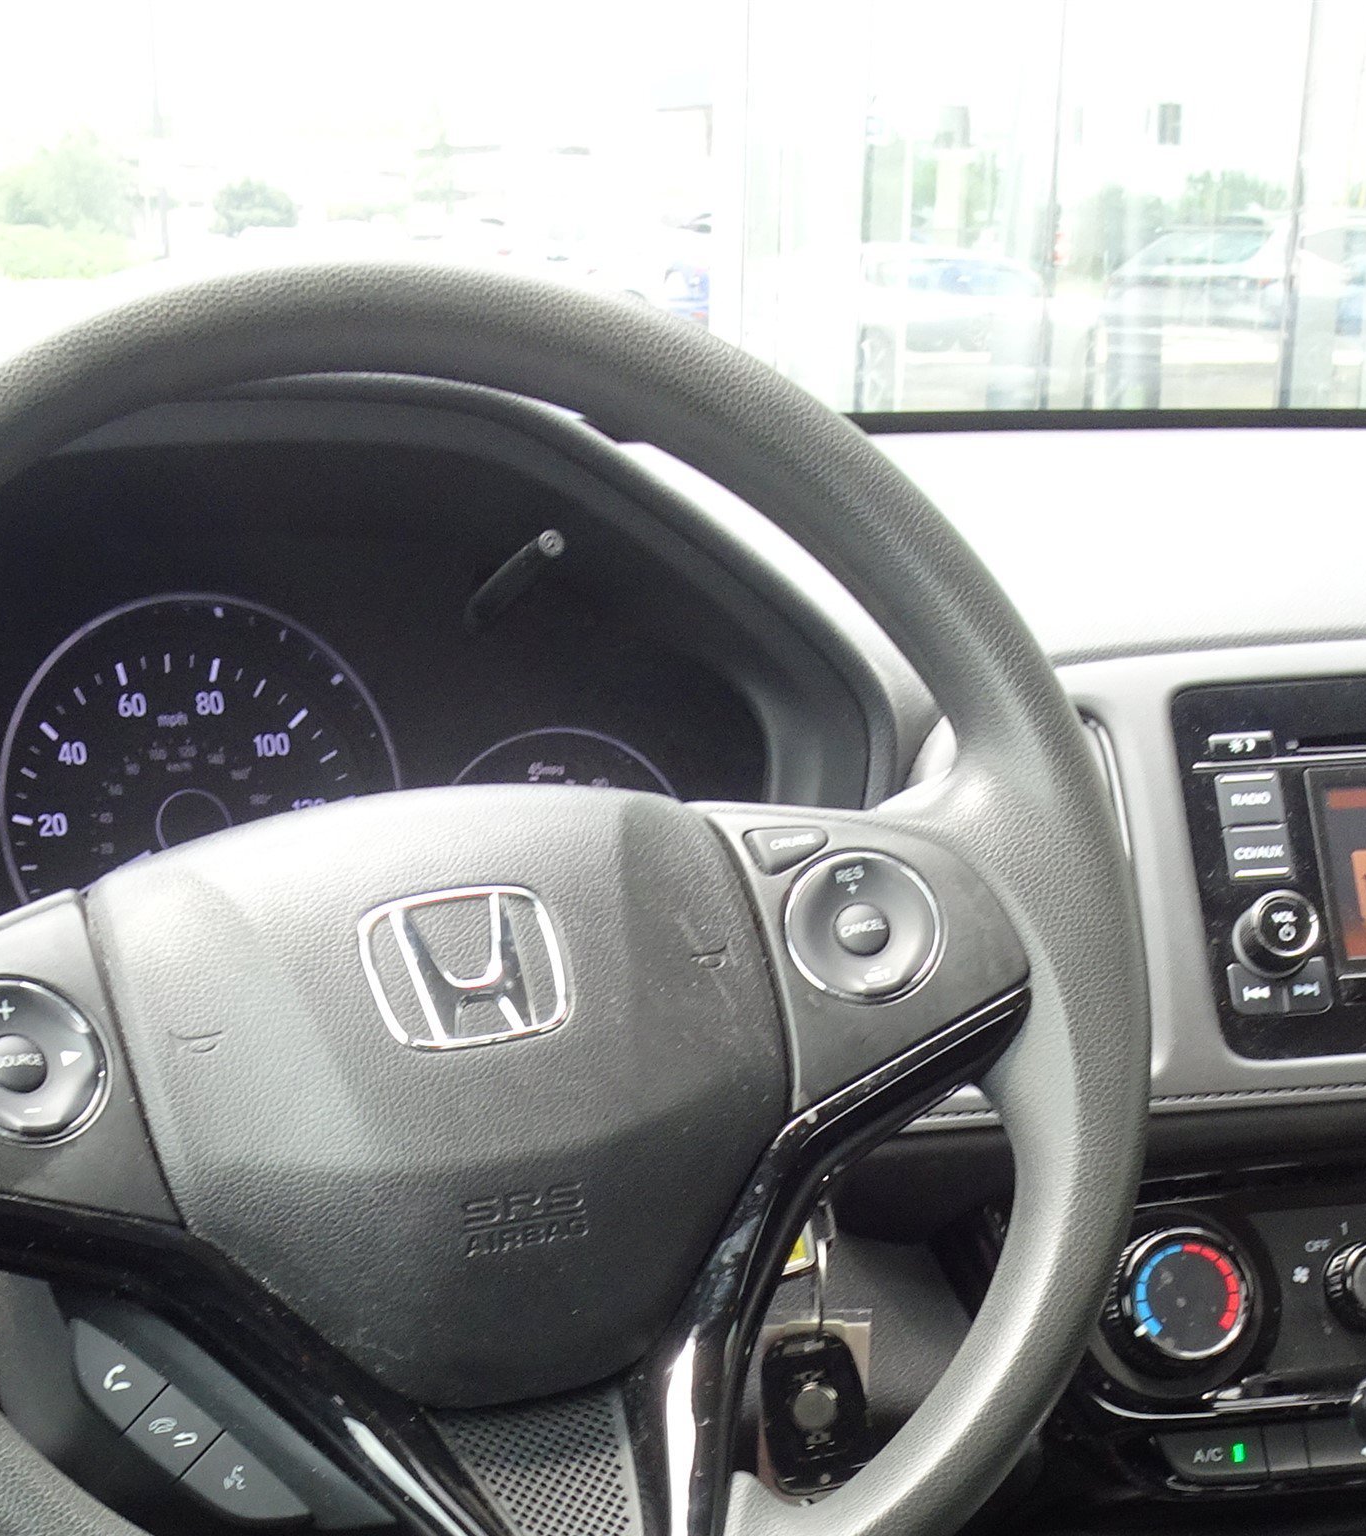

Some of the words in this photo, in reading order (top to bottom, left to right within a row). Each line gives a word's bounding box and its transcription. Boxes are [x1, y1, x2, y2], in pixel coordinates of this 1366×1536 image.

[118, 692, 147, 717] 60
[195, 690, 225, 716] 80
[58, 741, 88, 766] 40
[253, 732, 291, 758] 100
[1230, 791, 1272, 807] RADIO
[37, 812, 68, 837] 20
[770, 833, 817, 850] CRUISE
[1233, 845, 1285, 860] CD/AUX
[835, 865, 865, 883] RES
[840, 918, 887, 938] CANCEL
[1270, 910, 1297, 924] VOL
[462, 1180, 585, 1229] SRS
[464, 1217, 589, 1260] AIRBAG
[1304, 1238, 1332, 1252] OFF
[1340, 1221, 1348, 1236] 1
[1193, 1446, 1223, 1464] A/C
